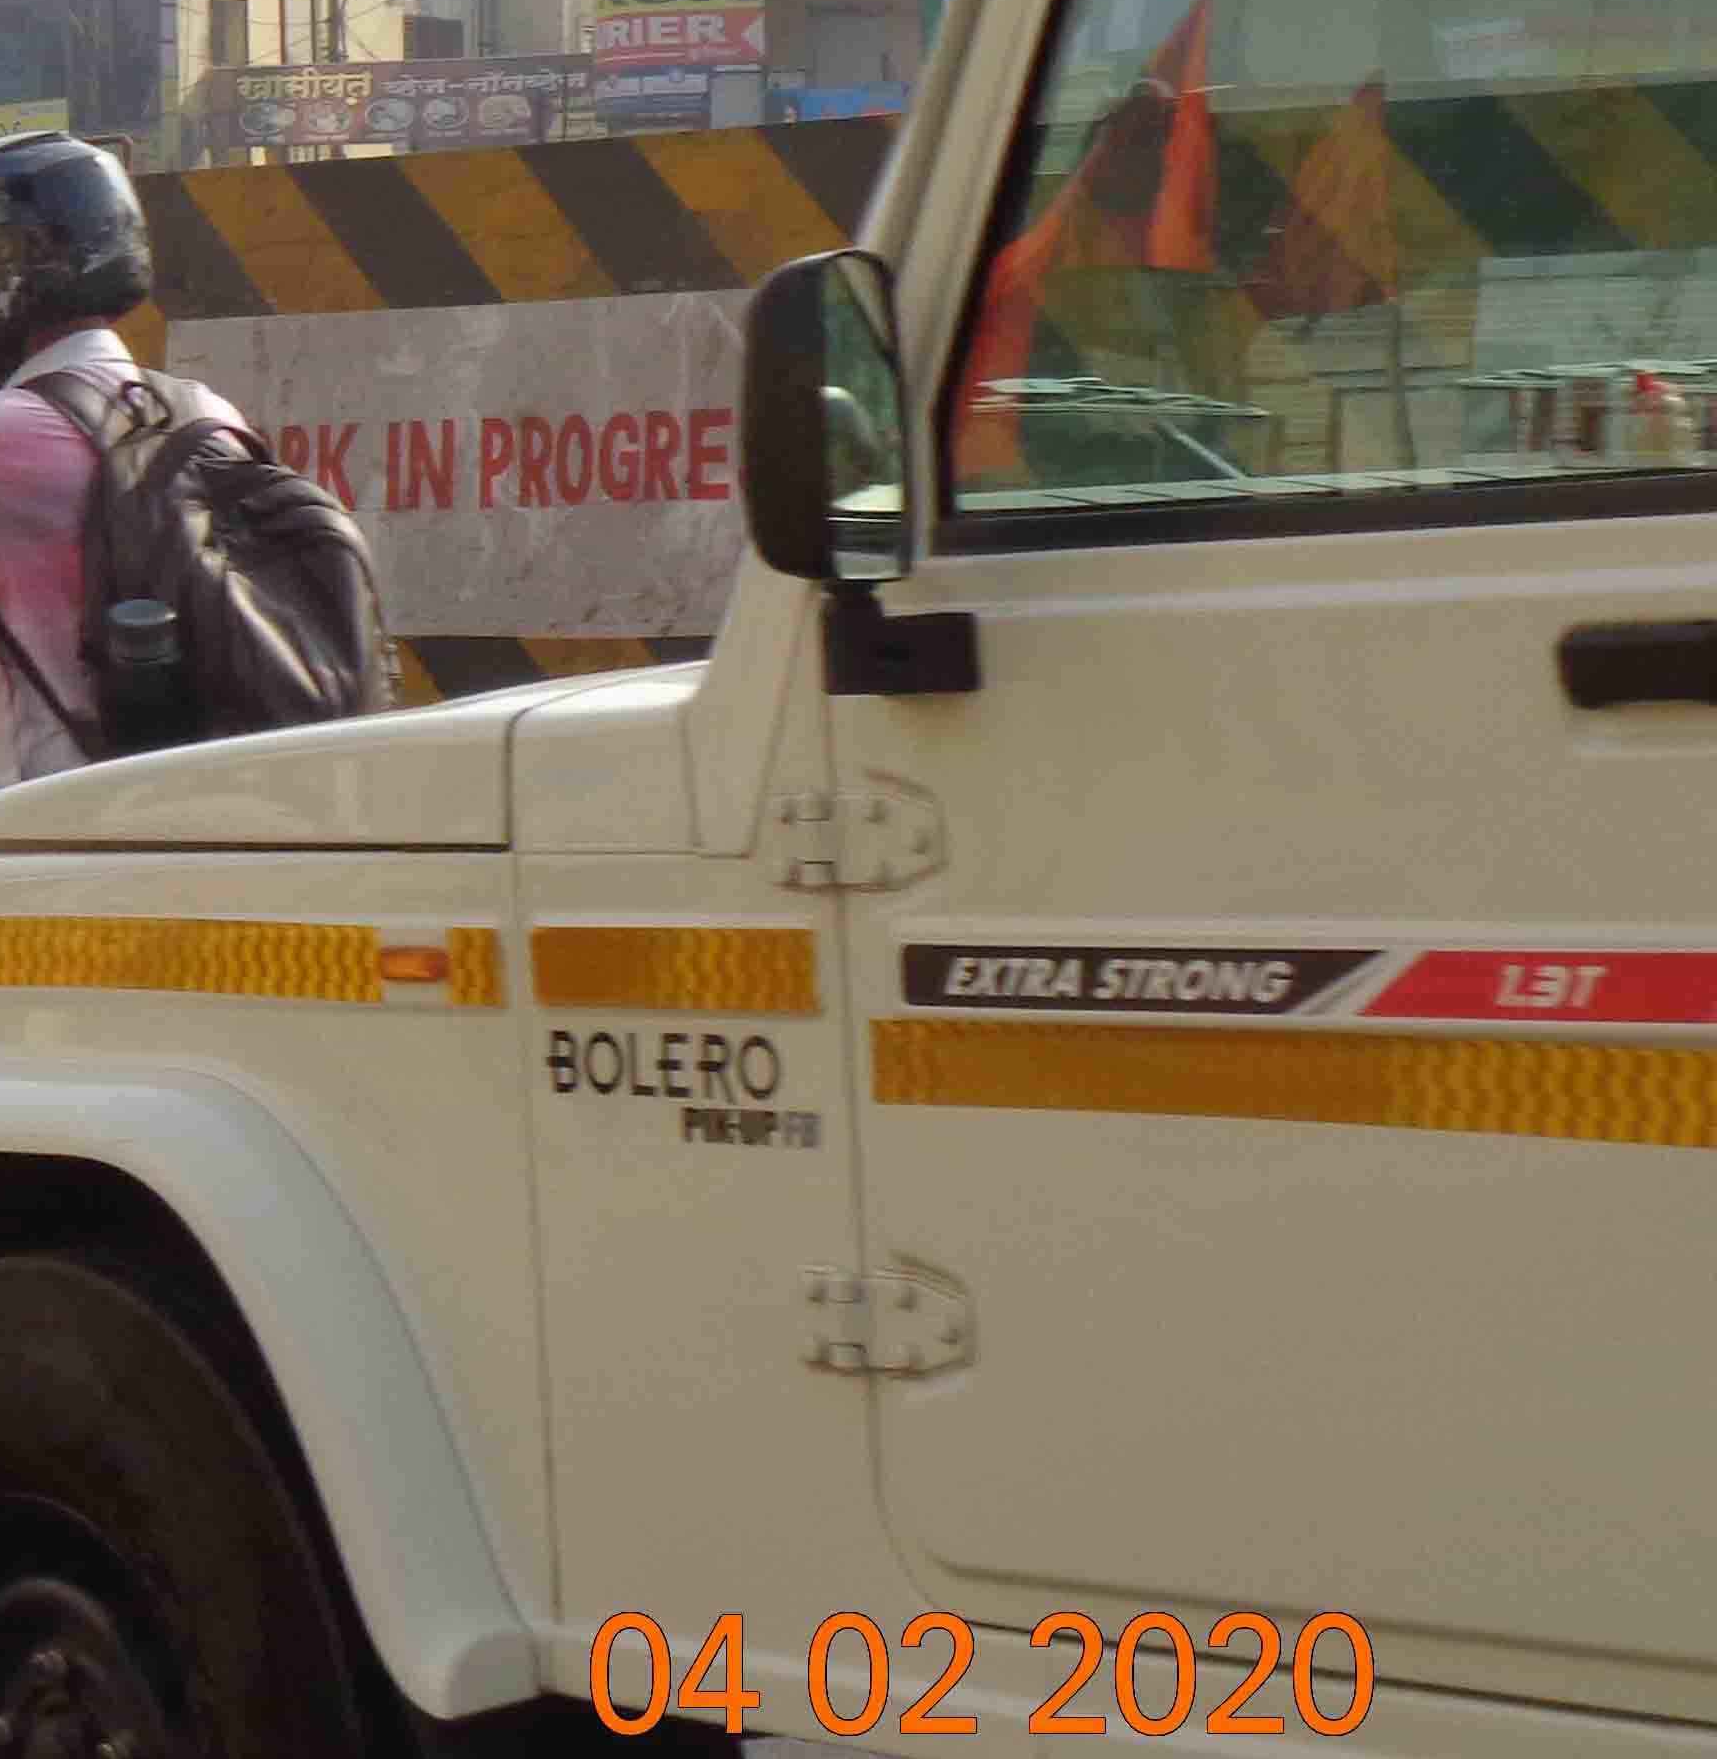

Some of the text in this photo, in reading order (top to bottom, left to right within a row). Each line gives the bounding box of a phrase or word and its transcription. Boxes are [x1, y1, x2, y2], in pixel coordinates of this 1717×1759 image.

[383, 418, 456, 513] IN
[478, 407, 733, 510] PROGRE
[944, 957, 1293, 1003] EXTRA STRONG
[547, 1030, 781, 1106] BOLERO
